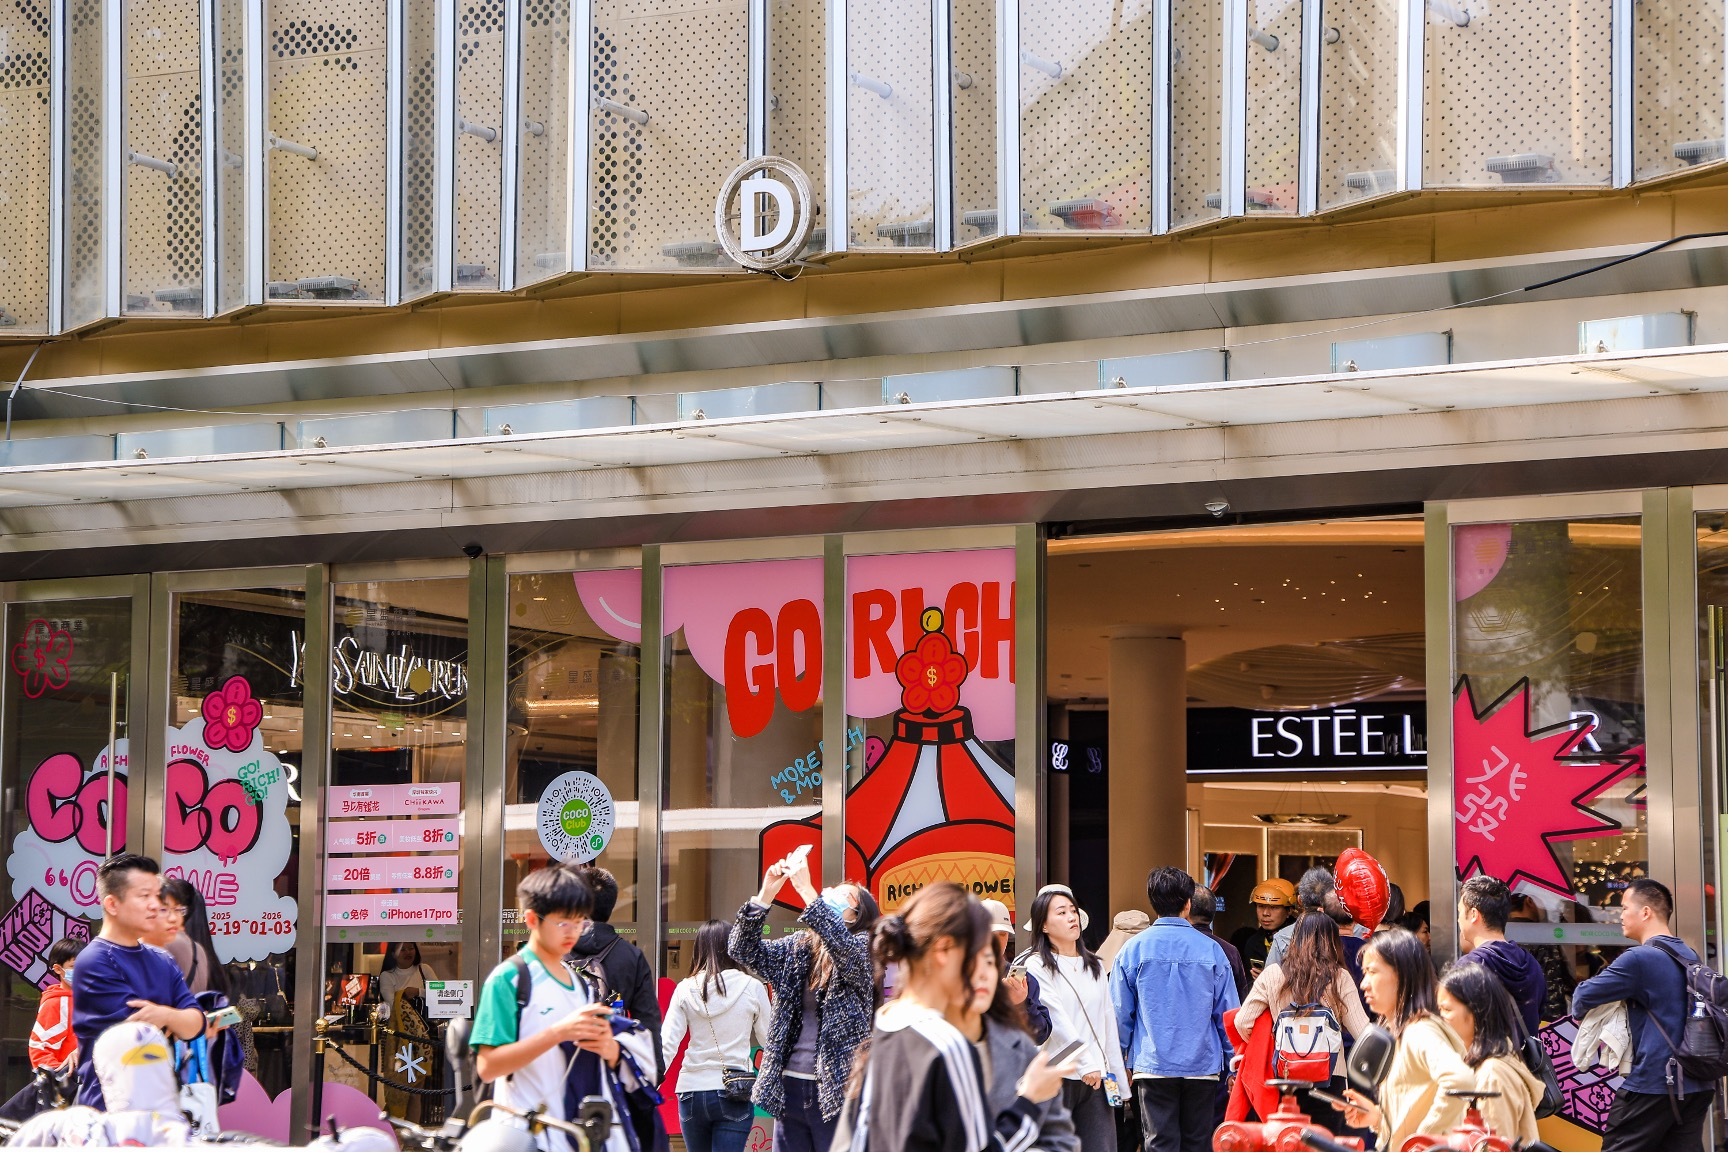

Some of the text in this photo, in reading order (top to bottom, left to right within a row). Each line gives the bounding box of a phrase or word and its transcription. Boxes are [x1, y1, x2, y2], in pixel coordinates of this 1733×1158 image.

[740, 178, 794, 252] D
[724, 581, 1016, 738] GO RICH
[170, 745, 210, 766] FLOWER
[237, 760, 260, 779] GO!
[770, 750, 821, 790] MORE
[241, 768, 280, 794] RICH!
[780, 788, 796, 804] &
[563, 808, 589, 820] COCO
[566, 819, 587, 829] Club
[343, 867, 371, 881] 20倍
[413, 866, 444, 880] 8.8折
[887, 878, 1015, 902] RICH LOWE
[211, 911, 282, 920] 2025 2026
[388, 908, 453, 920] iPhone17pro
[208, 918, 292, 936] 2-19~01-03
